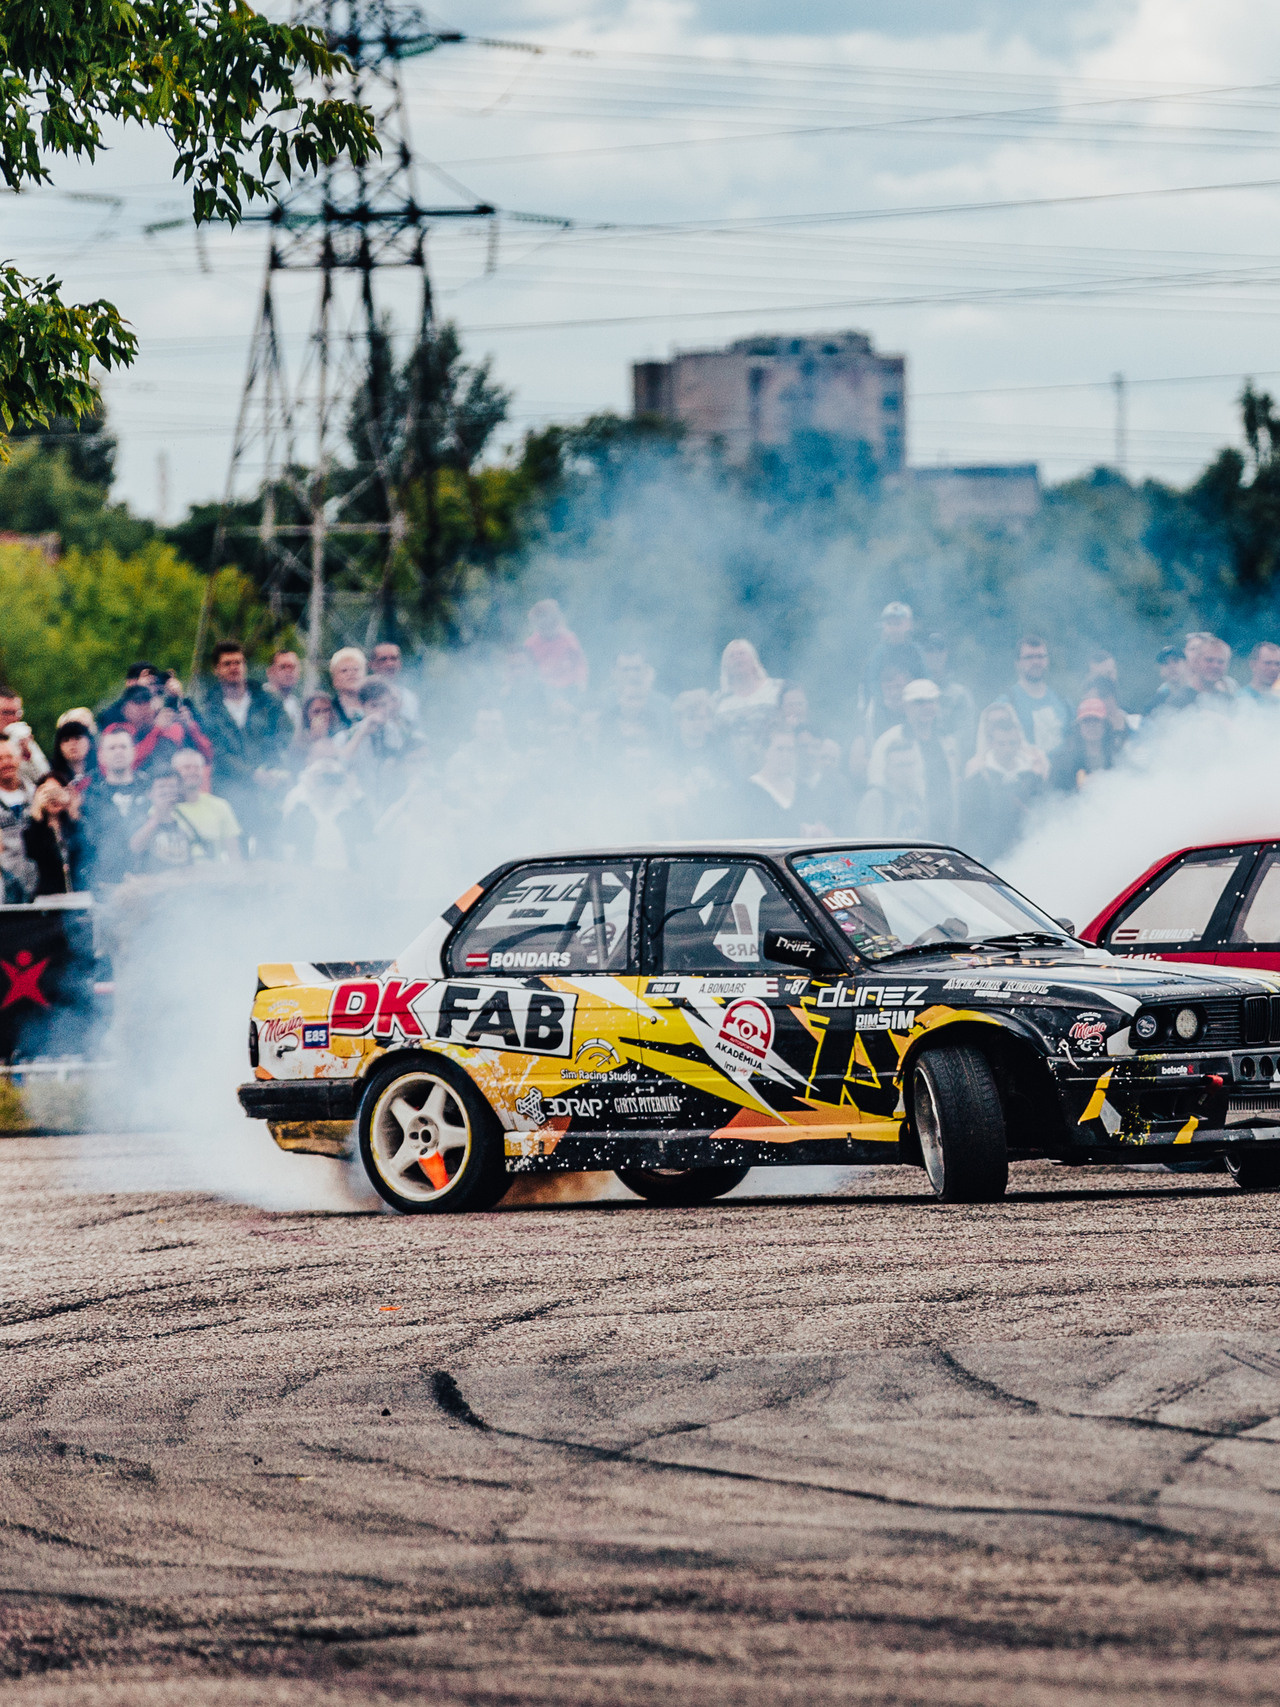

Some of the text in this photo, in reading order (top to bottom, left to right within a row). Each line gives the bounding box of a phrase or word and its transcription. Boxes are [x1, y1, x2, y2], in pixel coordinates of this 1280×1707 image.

[822, 889, 861, 910] LV87
[776, 936, 815, 957] DRIFT
[490, 952, 571, 968] BONDARS
[699, 982, 746, 994] A.BONDARS
[791, 979, 809, 995] 87
[330, 980, 565, 1050] DK FAB
[305, 1030, 326, 1042] E85
[560, 1069, 577, 1079] Sim
[579, 1070, 607, 1082] Racing
[1161, 1065, 1188, 1075] betsafe
[546, 1098, 602, 1117] 3DRAP
